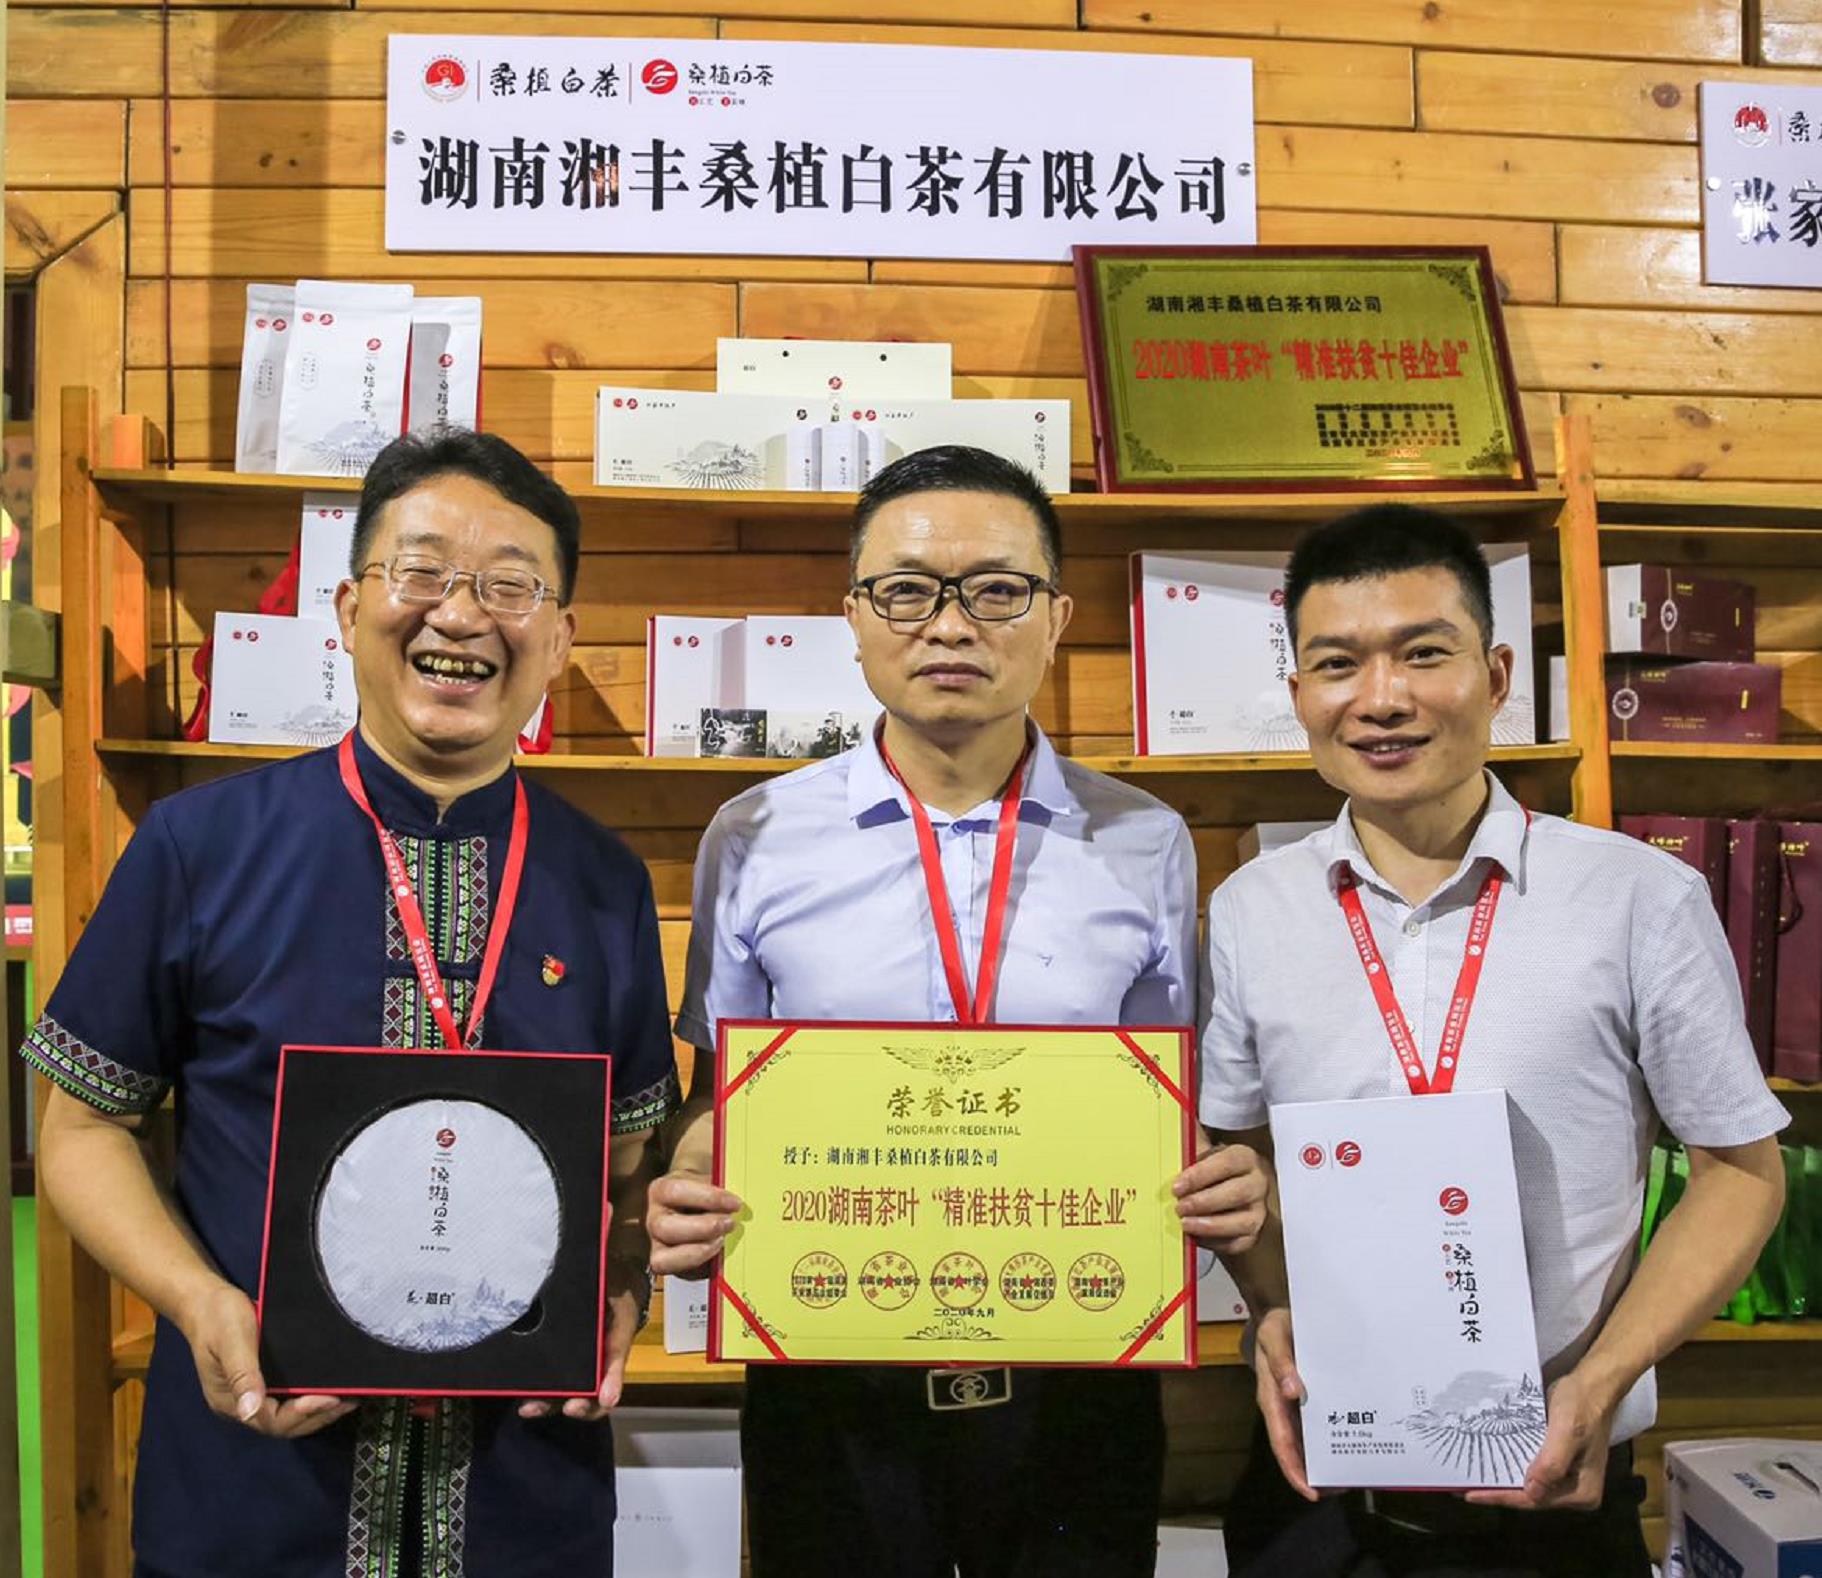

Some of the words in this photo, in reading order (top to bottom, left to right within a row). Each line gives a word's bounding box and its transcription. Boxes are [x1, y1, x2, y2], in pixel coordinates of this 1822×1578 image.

[489, 62, 620, 97] 桑植白茶
[688, 62, 774, 87] 桑植白茶
[1788, 111, 1822, 143] 桑
[418, 135, 1227, 224] 湖南湘丰桑植白茶有限公司
[1146, 294, 1383, 314] 湖南湘丰桑植白茶有限公司
[886, 1085, 1022, 1119] 荣誉证书
[886, 1125, 950, 1136] HONORARY
[951, 1125, 1022, 1136] CREDENTIAL
[1453, 1243, 1482, 1343] 桑植白茶
